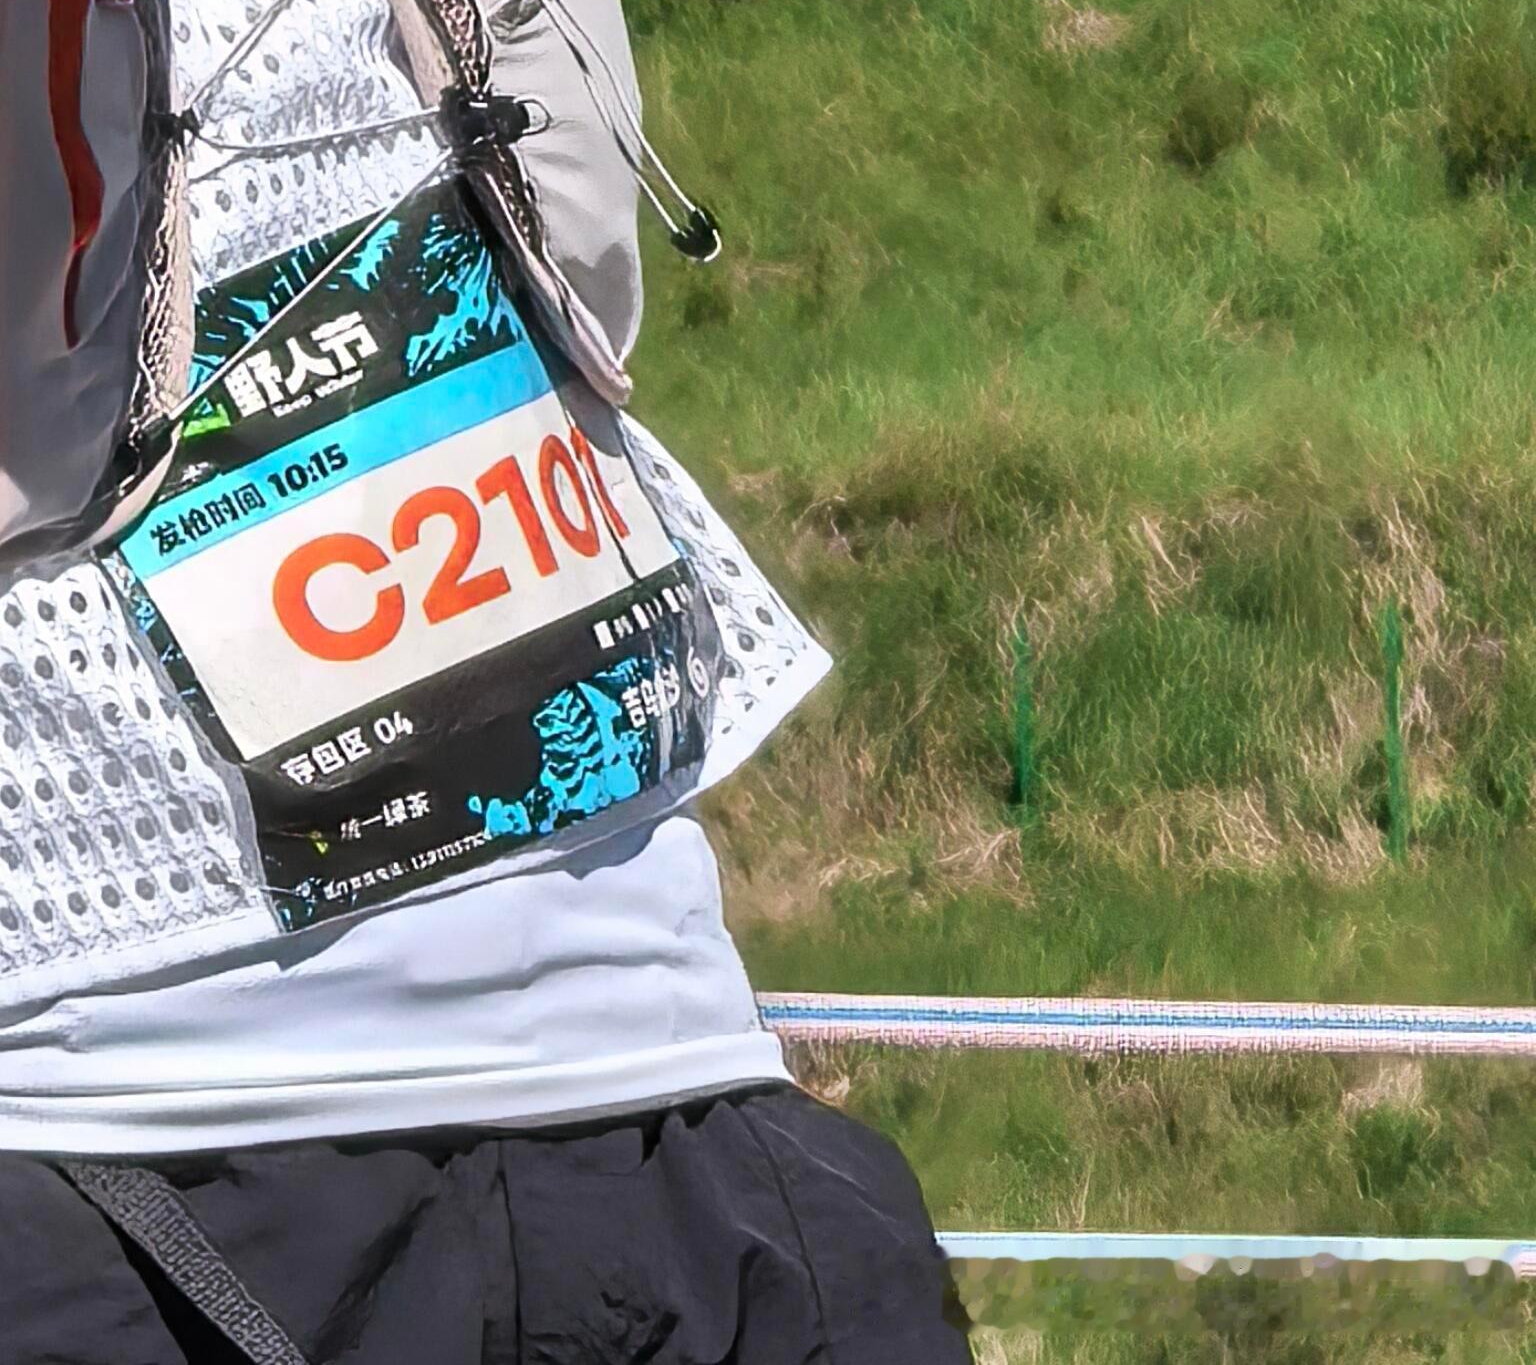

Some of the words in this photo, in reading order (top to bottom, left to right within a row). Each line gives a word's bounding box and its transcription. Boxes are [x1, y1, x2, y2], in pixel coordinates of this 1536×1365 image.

[224, 311, 380, 418] 野人节
[150, 482, 267, 557] 发枪时间
[267, 443, 349, 498] 10:15
[374, 711, 414, 744] 04
